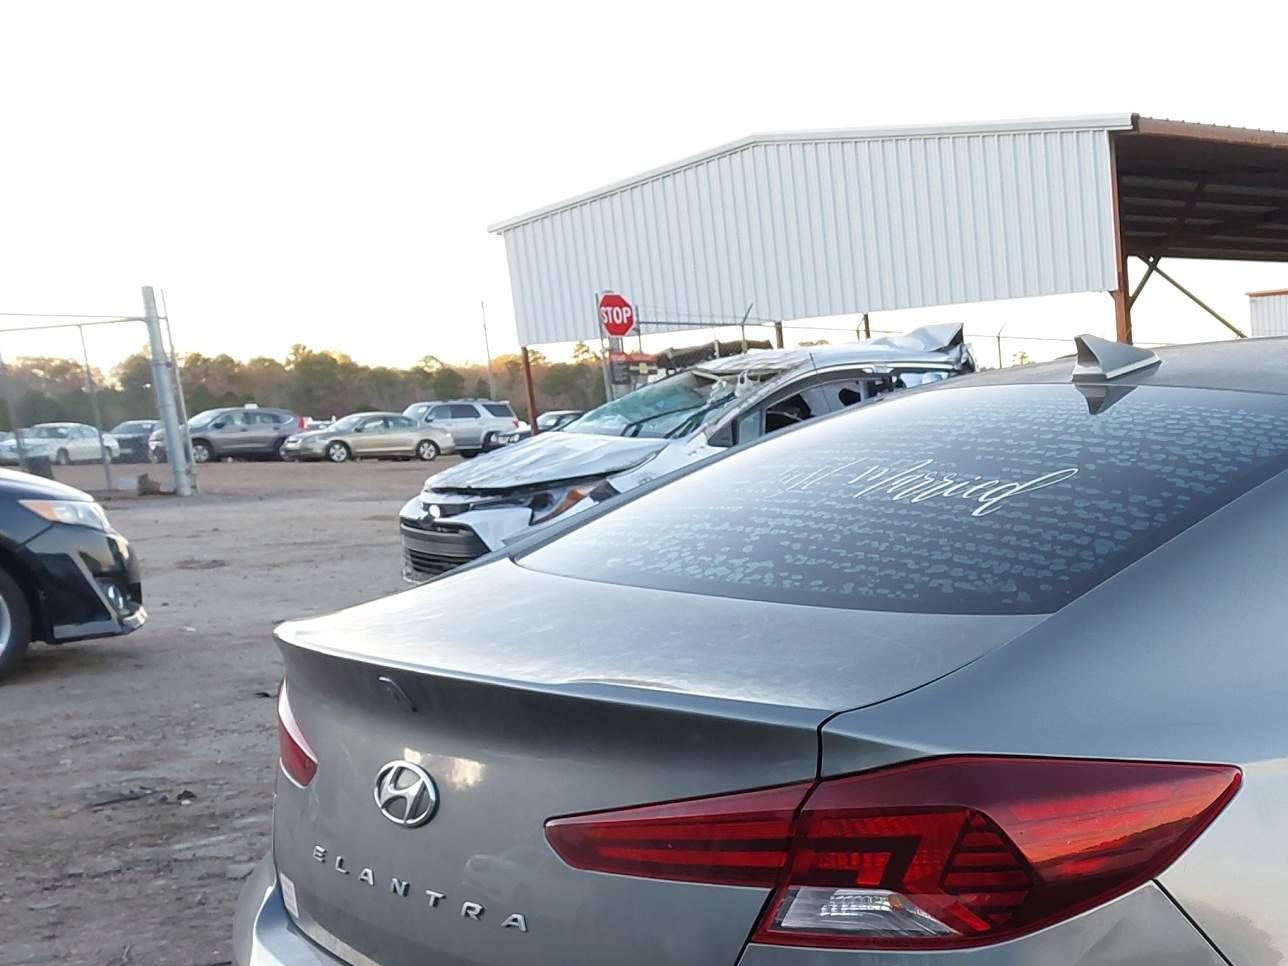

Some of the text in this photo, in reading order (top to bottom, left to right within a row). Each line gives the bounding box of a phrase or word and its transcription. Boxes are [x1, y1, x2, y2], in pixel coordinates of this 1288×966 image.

[600, 306, 632, 324] STOP
[848, 458, 1079, 517] Married
[312, 845, 528, 932] ELANTRA
